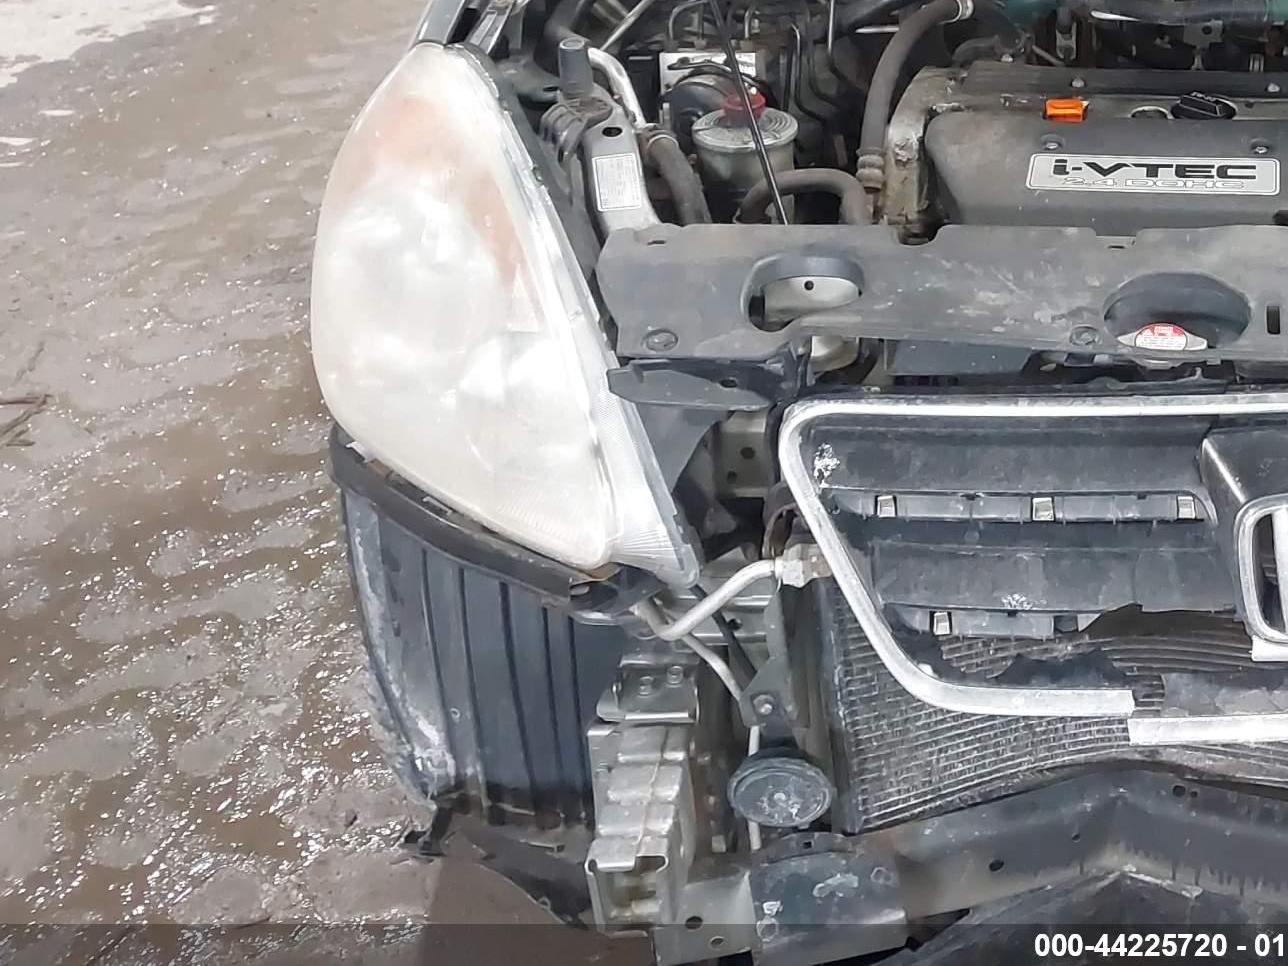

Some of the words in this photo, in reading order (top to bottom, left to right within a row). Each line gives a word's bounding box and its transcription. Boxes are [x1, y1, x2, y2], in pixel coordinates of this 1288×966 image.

[1052, 158, 1257, 181] i-VTEC
[1062, 176, 1118, 187] 2.4
[1124, 178, 1246, 189] DOHC
